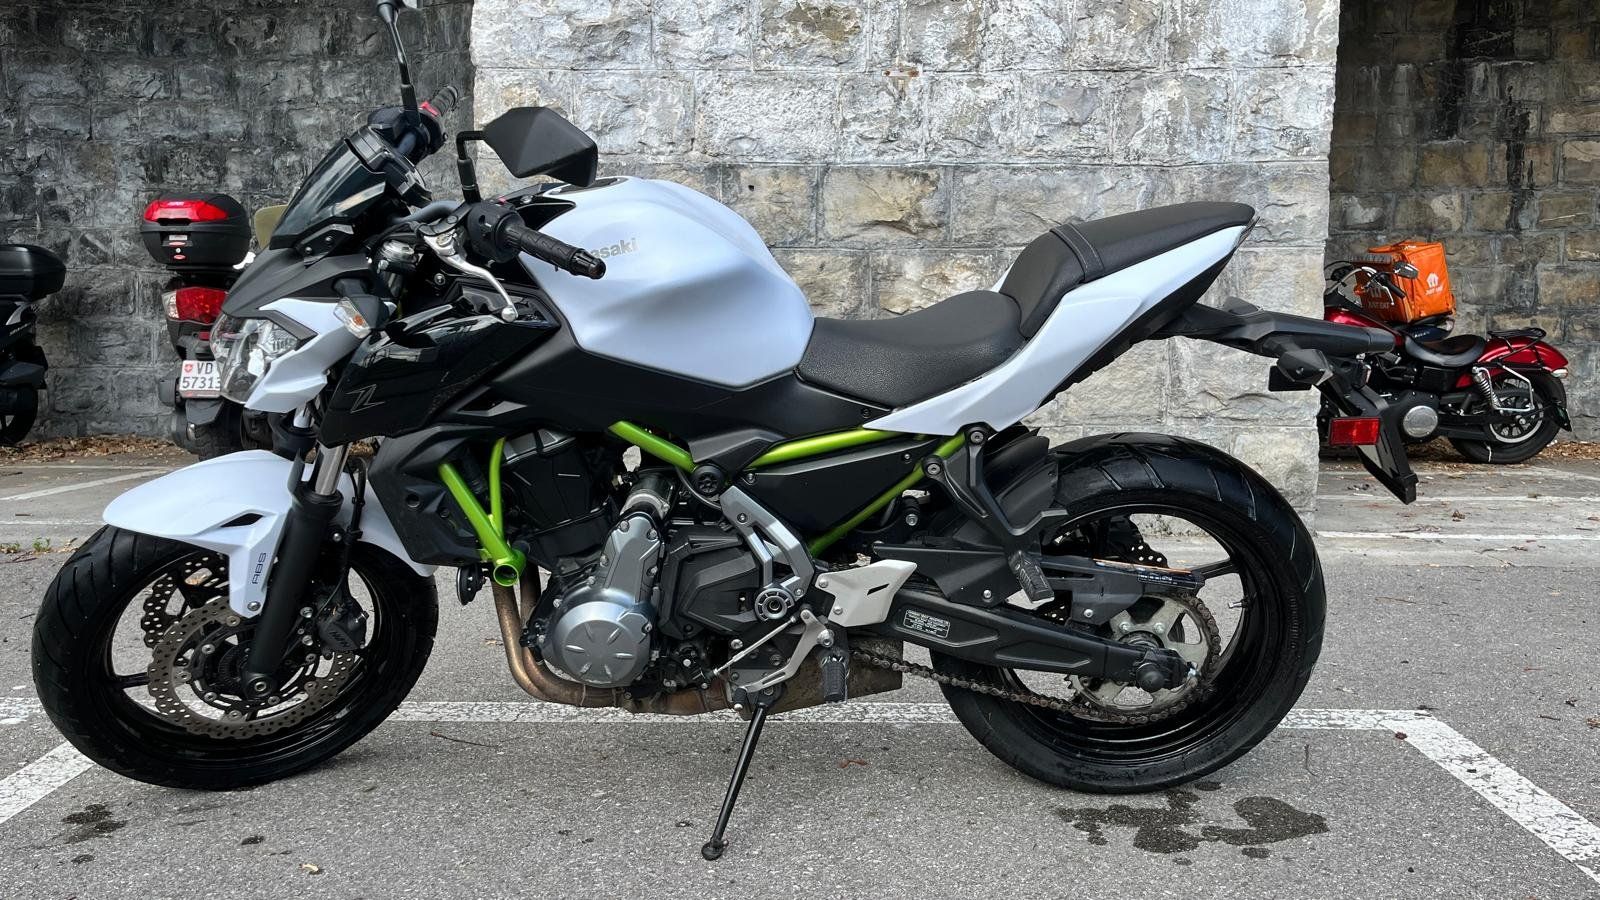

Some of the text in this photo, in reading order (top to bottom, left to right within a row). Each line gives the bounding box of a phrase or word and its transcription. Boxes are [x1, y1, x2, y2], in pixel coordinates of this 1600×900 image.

[591, 237, 636, 259] asaki
[197, 362, 213, 374] VD
[252, 552, 267, 585] ABS
